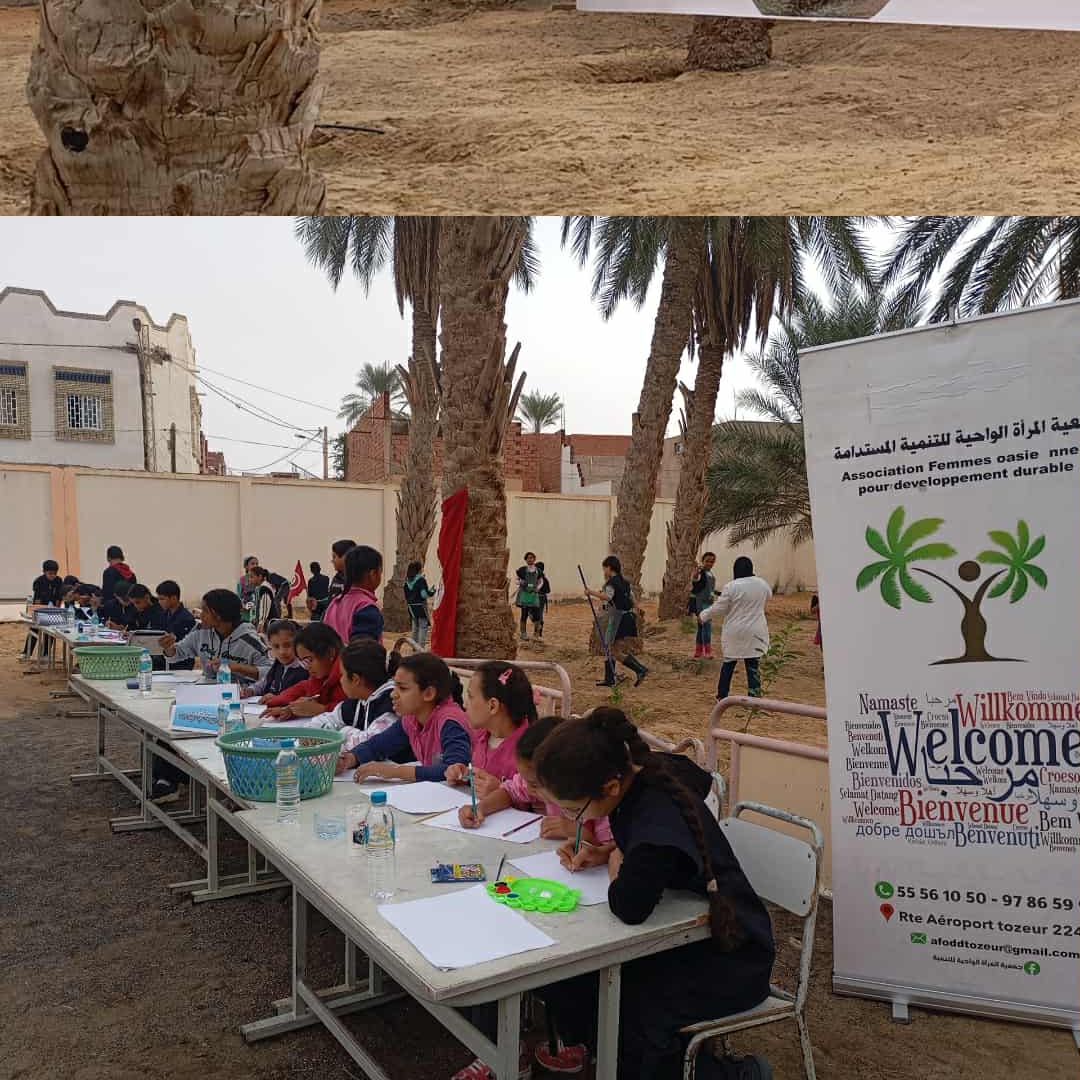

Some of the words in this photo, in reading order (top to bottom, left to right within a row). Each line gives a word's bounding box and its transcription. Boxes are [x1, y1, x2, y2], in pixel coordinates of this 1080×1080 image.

[899, 432, 952, 455] للتنمية
[955, 424, 1009, 448] الواحية
[833, 439, 897, 461] المستدامة
[841, 464, 924, 483] Association
[928, 456, 992, 472] Femmes
[996, 449, 1040, 464] oasie
[1048, 446, 1080, 458] nne
[858, 483, 889, 497] pour
[893, 469, 1009, 491] developpement
[1012, 461, 1075, 478] durable
[859, 693, 918, 715] Namaste
[851, 771, 922, 791] Bienvenidos
[853, 801, 900, 818] Welcome
[897, 788, 1029, 827] Bienvenue
[855, 822, 901, 839] добре
[905, 826, 955, 841] дошъл
[1040, 810, 1073, 832] Bem
[953, 821, 1040, 850] Benvenuti
[897, 885, 915, 899] 55
[919, 887, 939, 901] 56
[942, 889, 961, 903] 10
[966, 891, 987, 905] 50
[1002, 894, 1022, 908] 97
[1026, 896, 1047, 909] 86
[1052, 897, 1074, 911] 59
[899, 911, 923, 924] Rte
[926, 914, 994, 931] Aéroport
[998, 921, 1049, 936] tozeur
